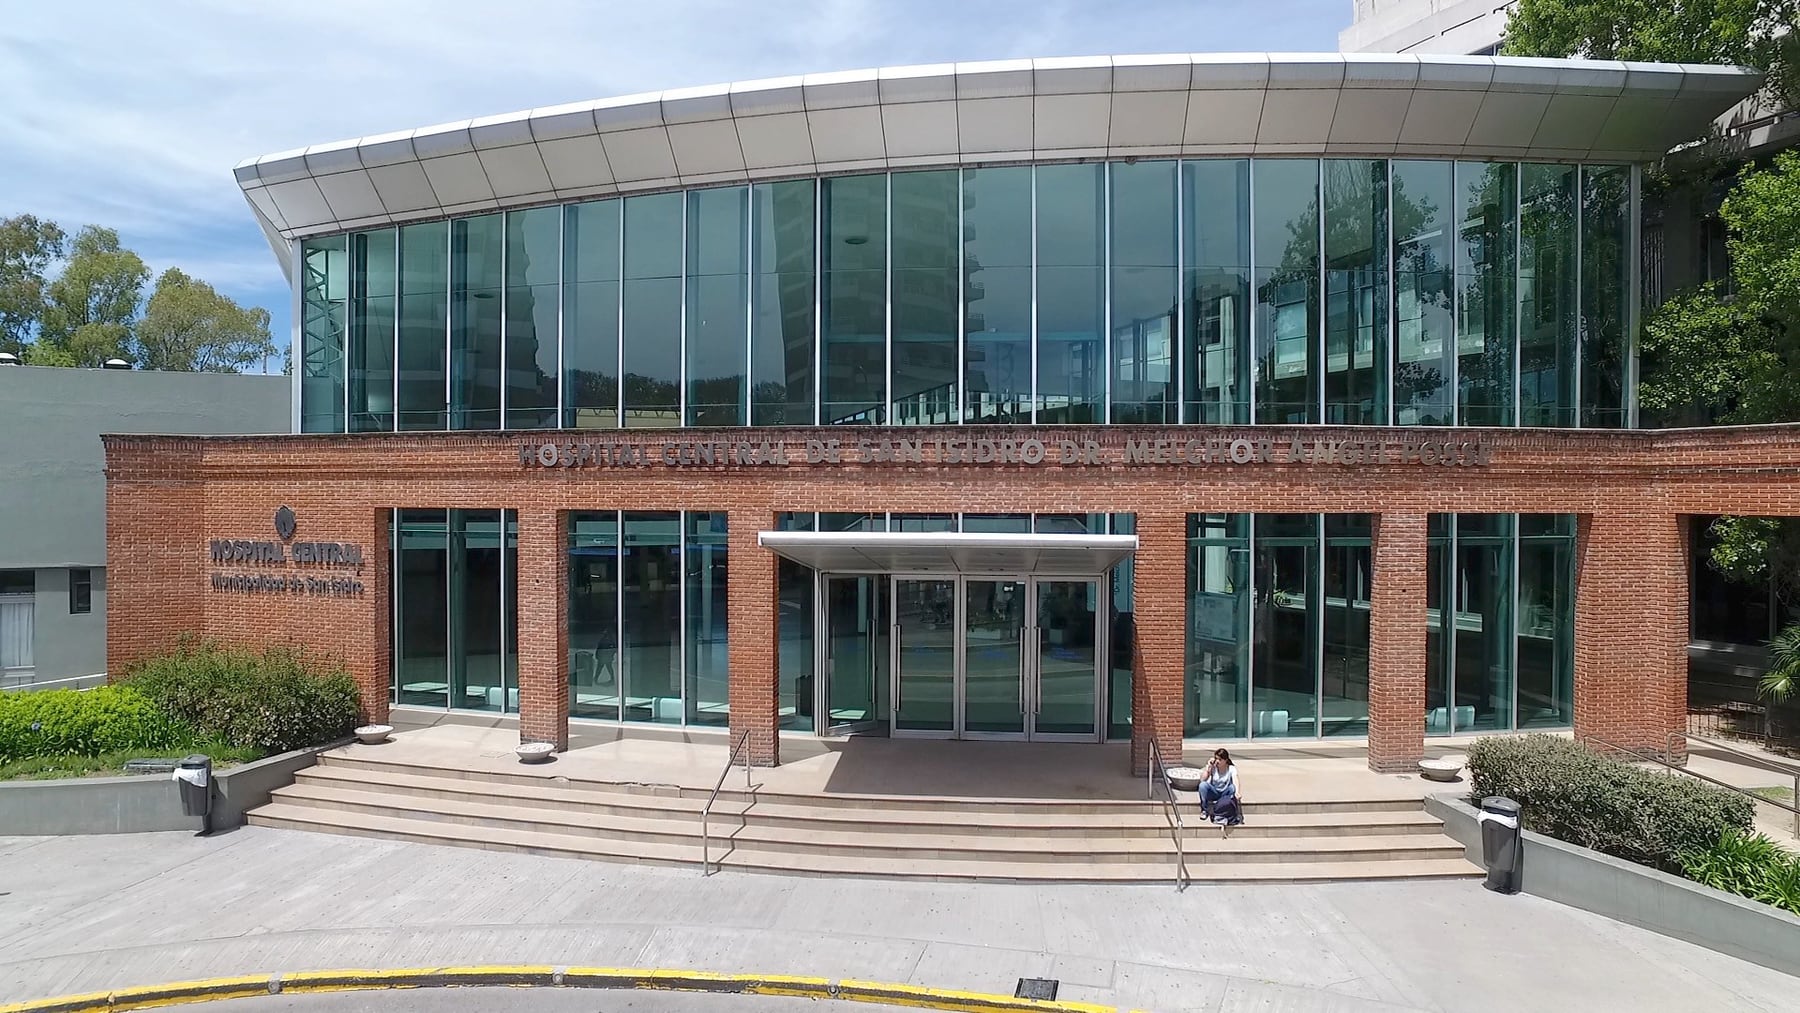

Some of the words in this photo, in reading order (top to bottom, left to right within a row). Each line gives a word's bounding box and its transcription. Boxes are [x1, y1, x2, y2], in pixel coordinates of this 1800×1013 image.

[518, 442, 651, 467] HOSPITAL
[661, 440, 790, 466] CENTRAL
[806, 438, 841, 464] DE
[858, 438, 923, 464] SAN
[935, 438, 1046, 465] ISIDRO
[1060, 439, 1111, 465] DR.
[1125, 438, 1274, 465] MELCHOR
[1403, 440, 1490, 467] POSSE
[211, 540, 285, 562] HOSPITAL
[292, 543, 363, 564] CENTRAL
[212, 573, 286, 593] Municipalidad
[289, 574, 304, 590] de
[305, 576, 326, 592] San
[327, 576, 363, 594] Isidro
